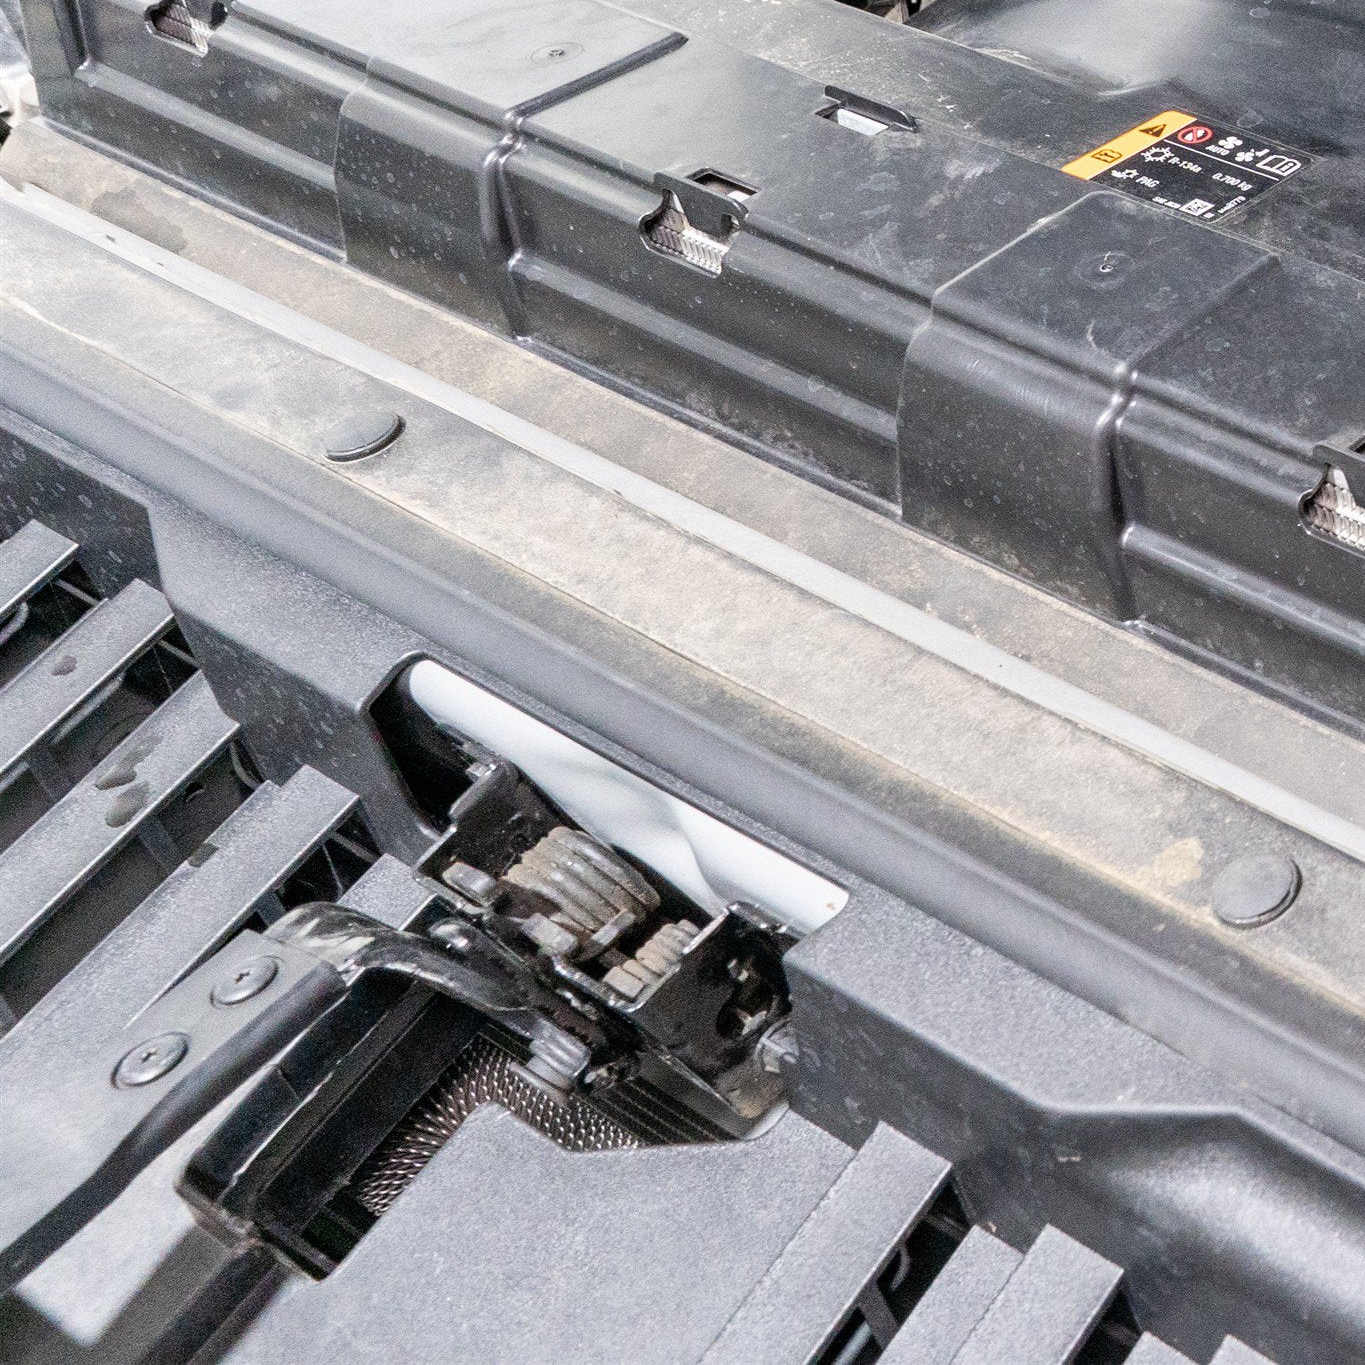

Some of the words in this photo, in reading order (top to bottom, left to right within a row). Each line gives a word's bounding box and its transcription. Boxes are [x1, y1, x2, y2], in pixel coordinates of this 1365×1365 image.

[1205, 144, 1230, 156] AUTO
[1168, 156, 1203, 173] R-134a
[1212, 172, 1241, 186] 0.700
[1136, 175, 1160, 188] PAG
